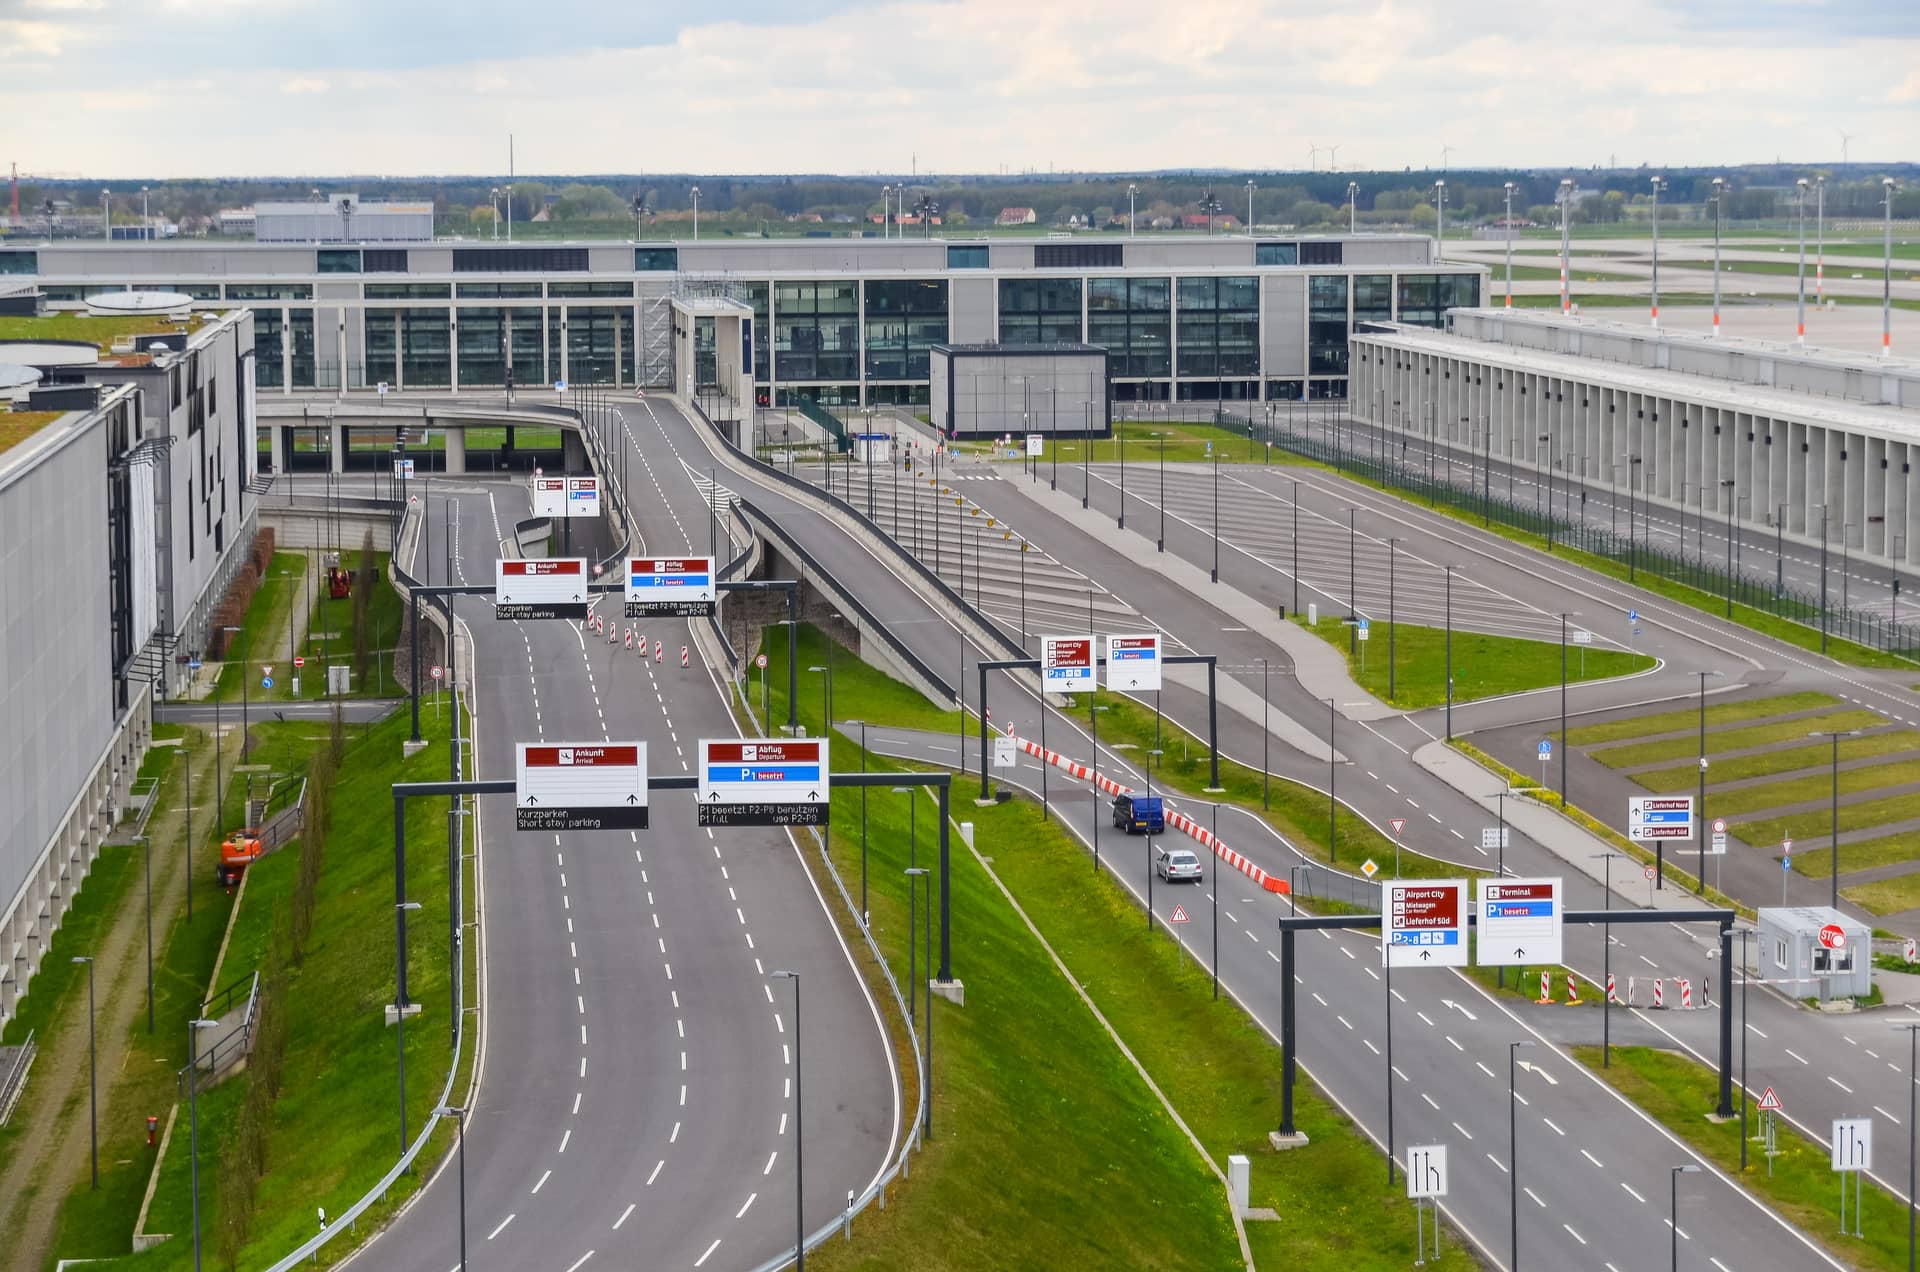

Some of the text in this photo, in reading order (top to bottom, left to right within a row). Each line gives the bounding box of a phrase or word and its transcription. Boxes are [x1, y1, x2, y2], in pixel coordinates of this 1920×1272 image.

[576, 749, 604, 757] Ankunft
[758, 746, 782, 754] Abflug
[712, 805, 746, 814] besetzt
[749, 805, 774, 814] P2-P8
[778, 805, 818, 814] benutzen
[518, 810, 568, 820] Kurzparken
[700, 815, 709, 823] P1
[712, 815, 728, 823] full
[792, 814, 817, 822] P2-P8
[518, 819, 600, 828] Short stay parking
[1431, 890, 1445, 899] City
